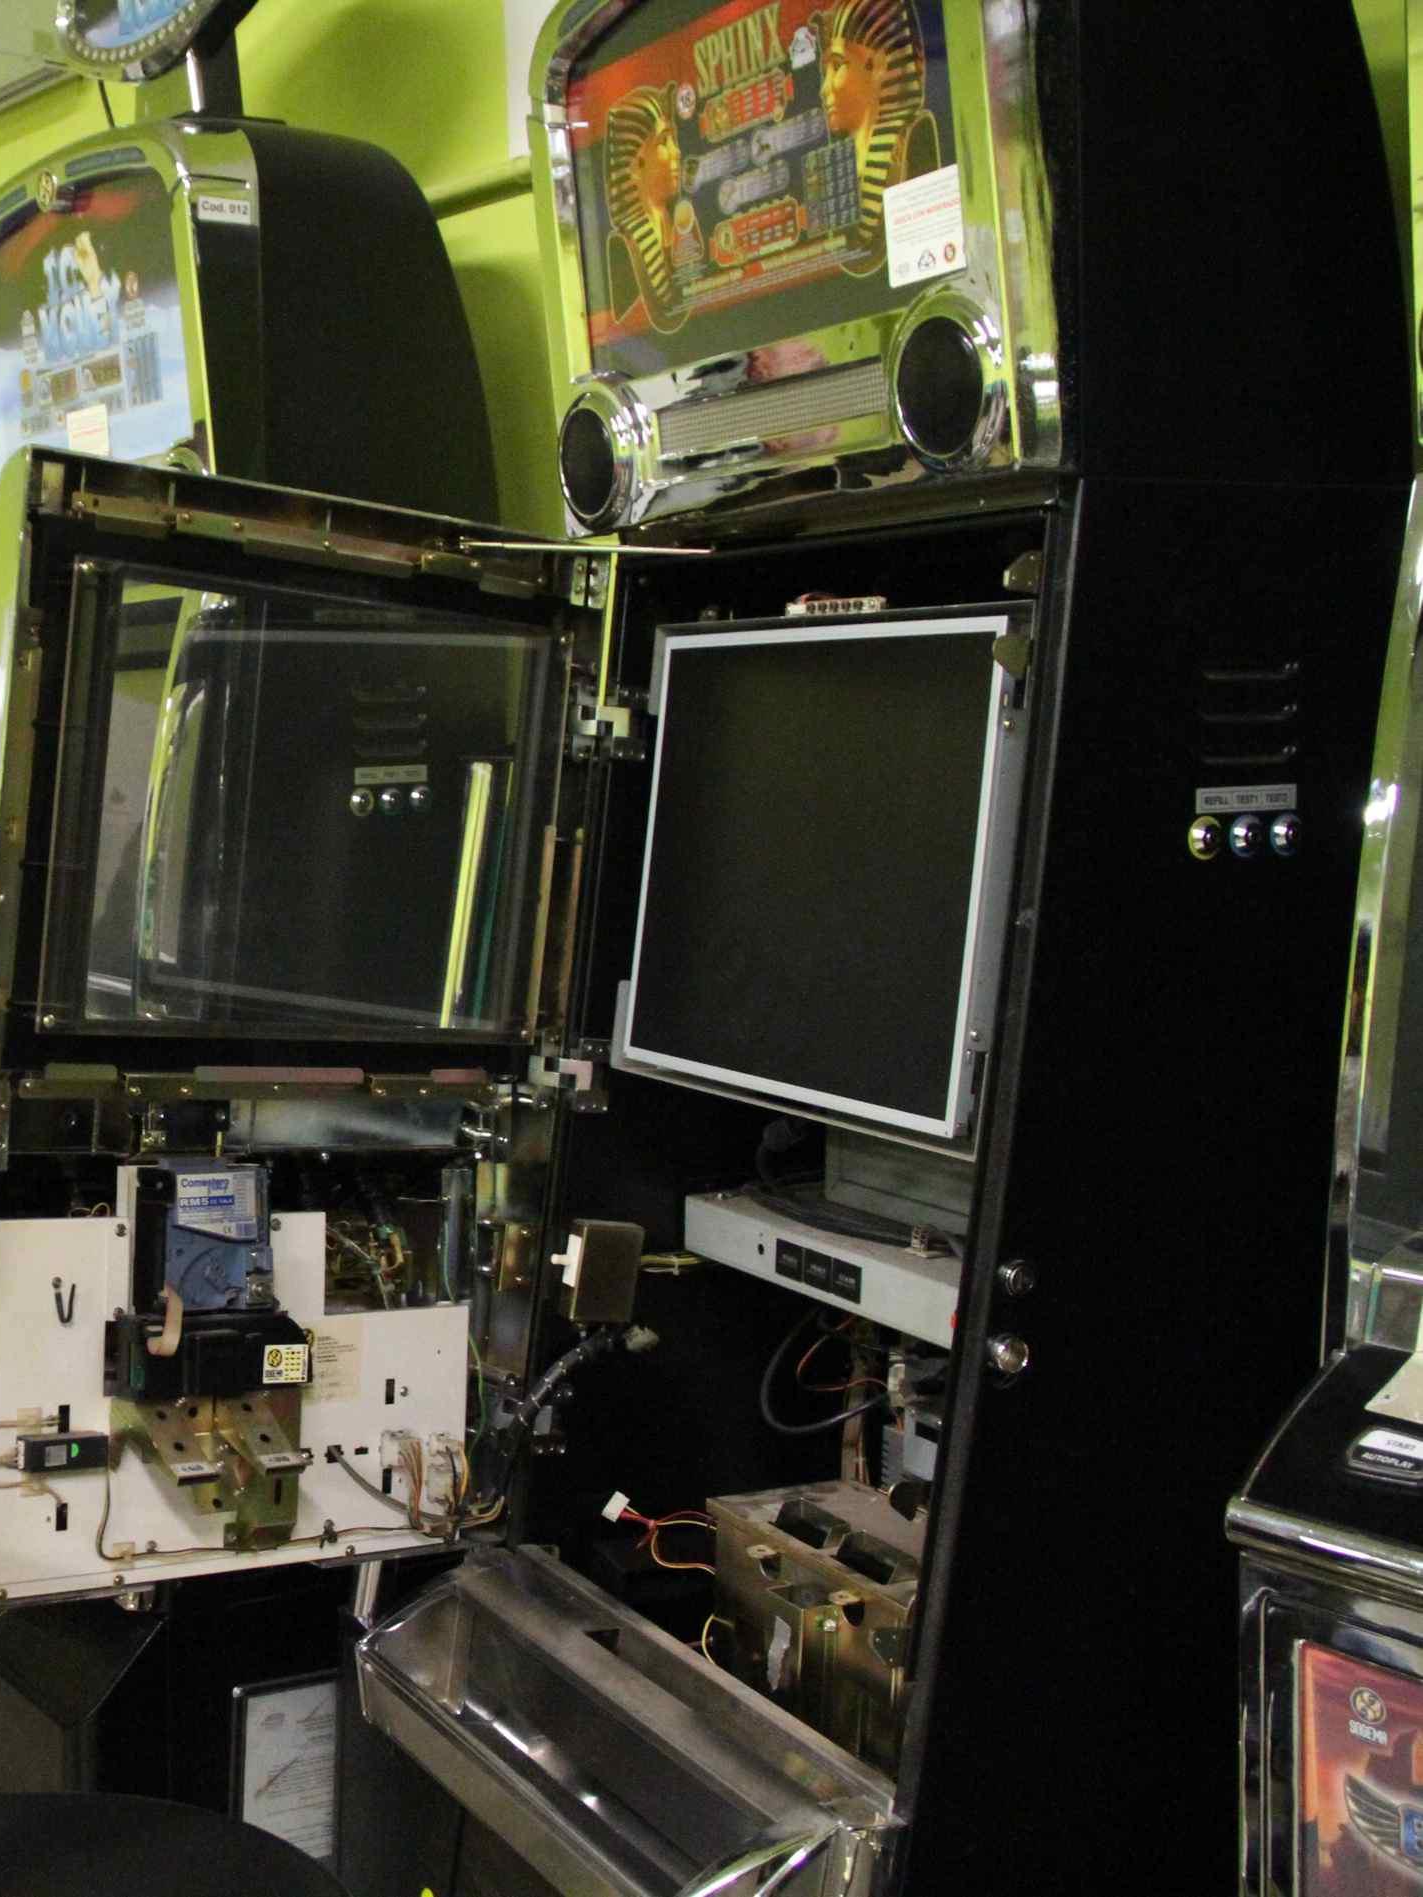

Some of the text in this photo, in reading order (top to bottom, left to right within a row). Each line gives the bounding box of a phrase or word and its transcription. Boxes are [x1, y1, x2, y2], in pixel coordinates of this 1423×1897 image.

[694, 2, 786, 98] SPHINX
[201, 200, 225, 212] Cod.
[1385, 1439, 1416, 1452] START
[1361, 1452, 1416, 1469] AUTOPLAY
